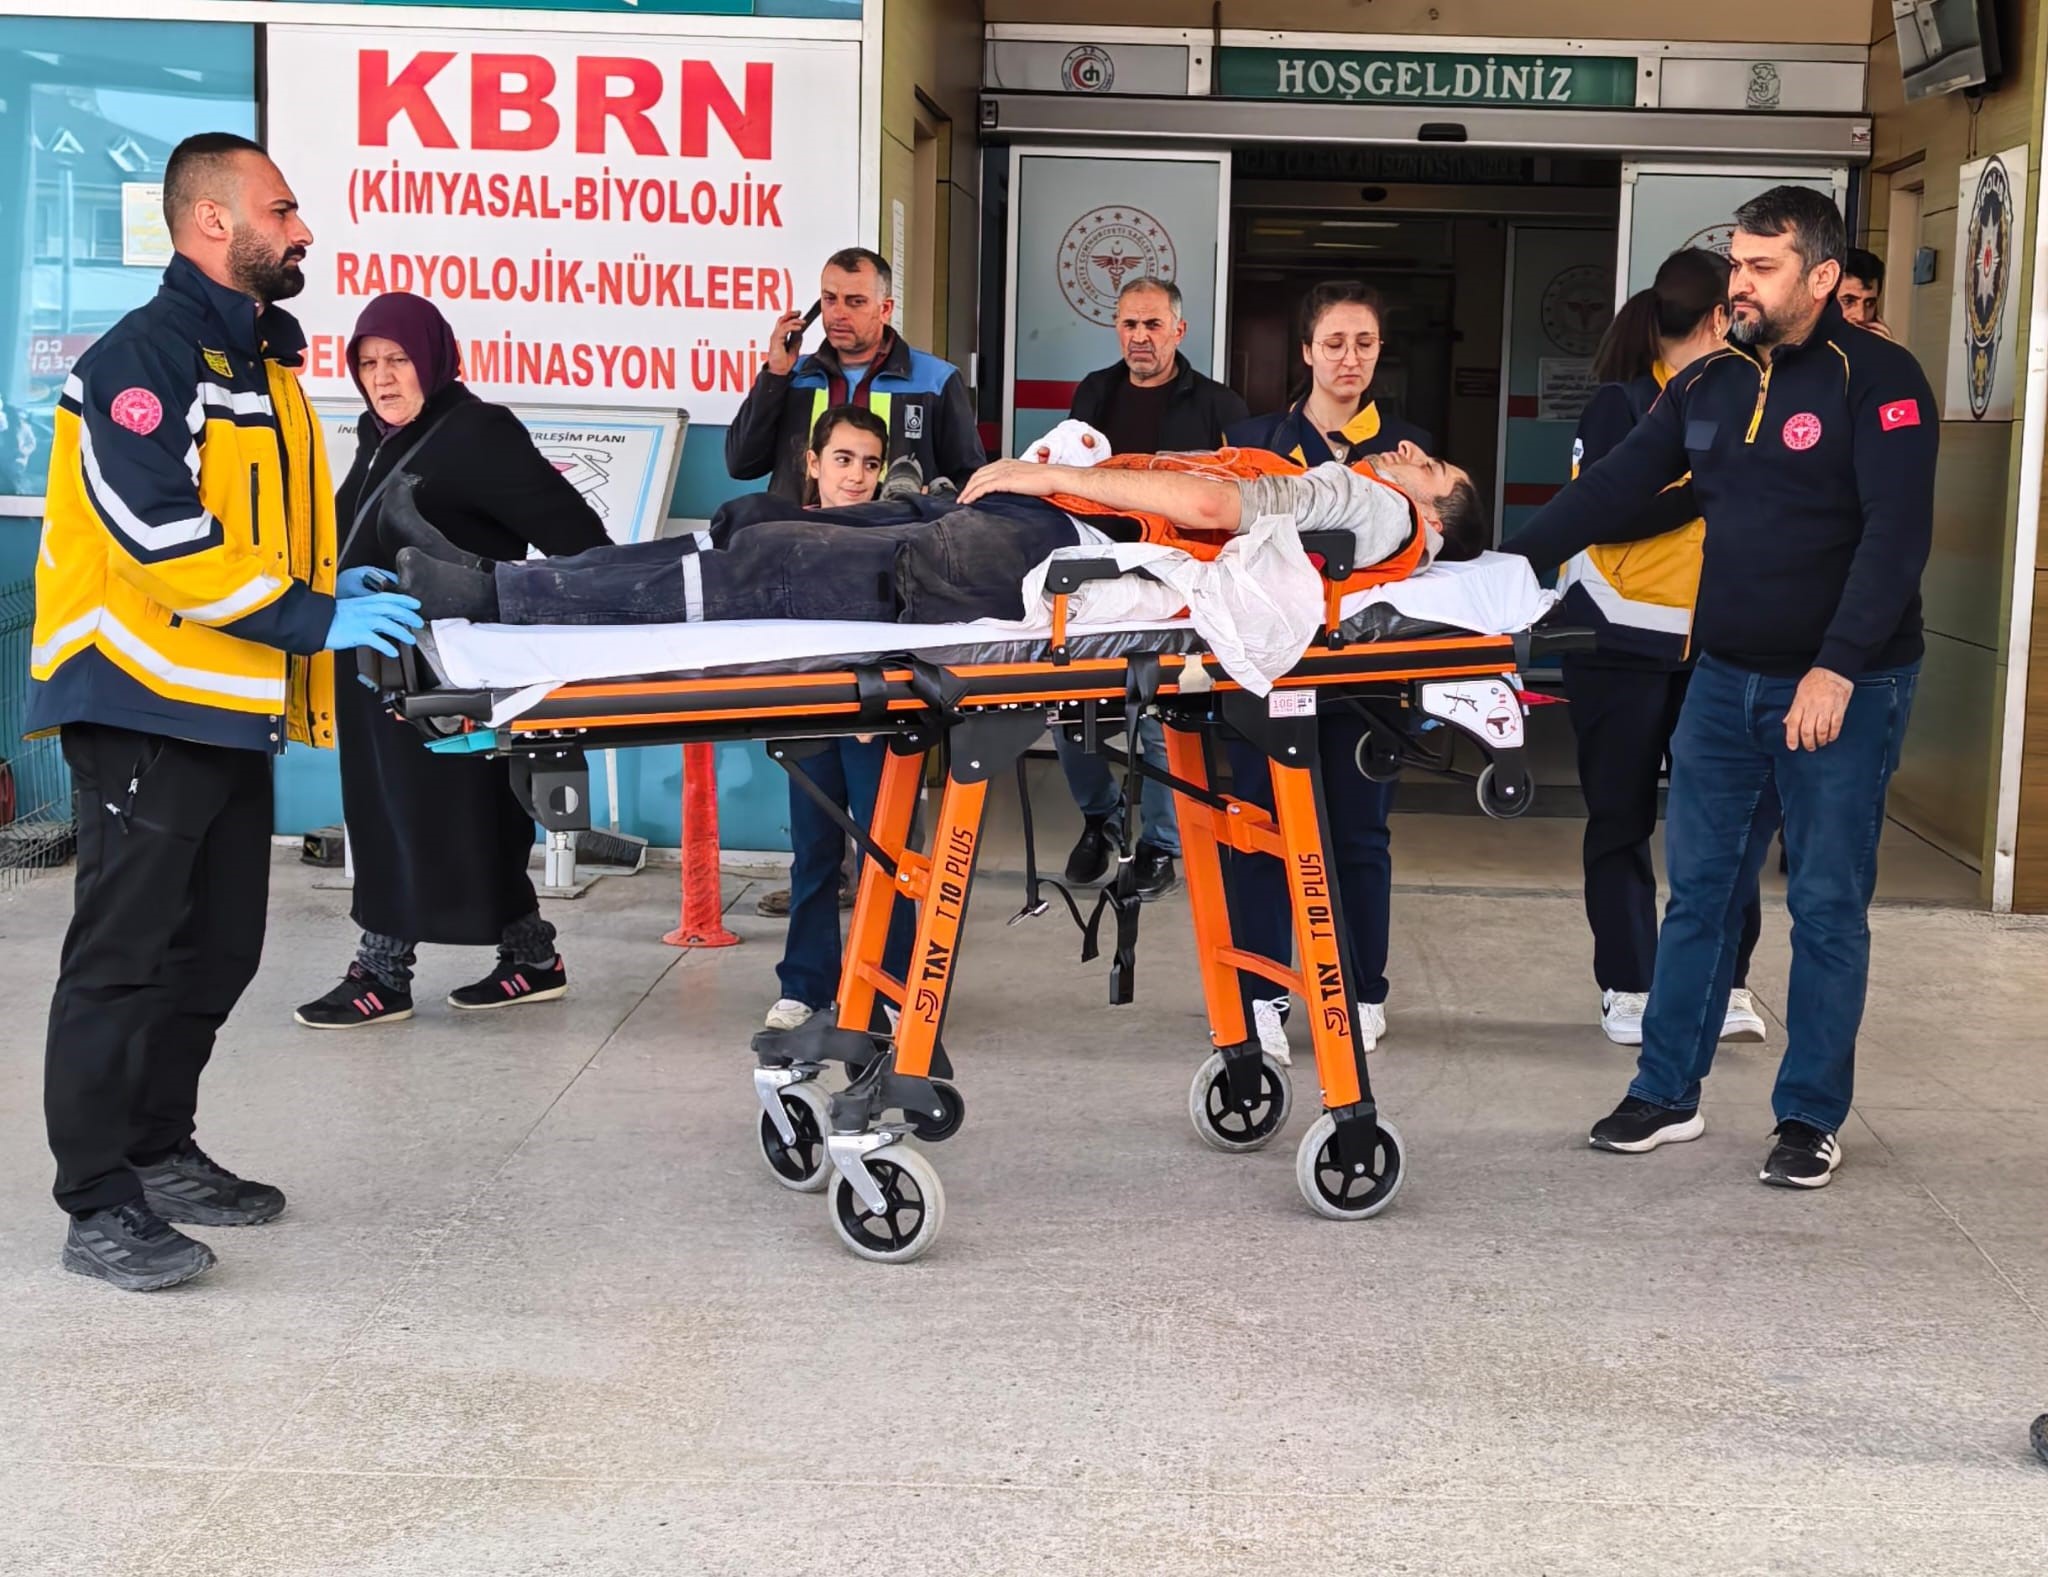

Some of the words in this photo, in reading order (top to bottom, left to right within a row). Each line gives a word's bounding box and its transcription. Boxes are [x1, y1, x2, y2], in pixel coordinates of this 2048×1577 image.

[357, 48, 775, 160] KBRN
[1276, 57, 1573, 101] HOŞGELDİNİZ
[348, 159, 784, 228] (KİMYASAL-BİYOLOJİK
[336, 248, 795, 313] RADYOLOJİK-NÜKLEER)
[531, 431, 583, 443] RLEŞİM
[586, 433, 626, 443] PLANI
[1298, 853, 1327, 897] PLUS
[922, 939, 950, 981] TAY
[945, 825, 974, 878] PLUS
[1316, 961, 1343, 1002] TAY
